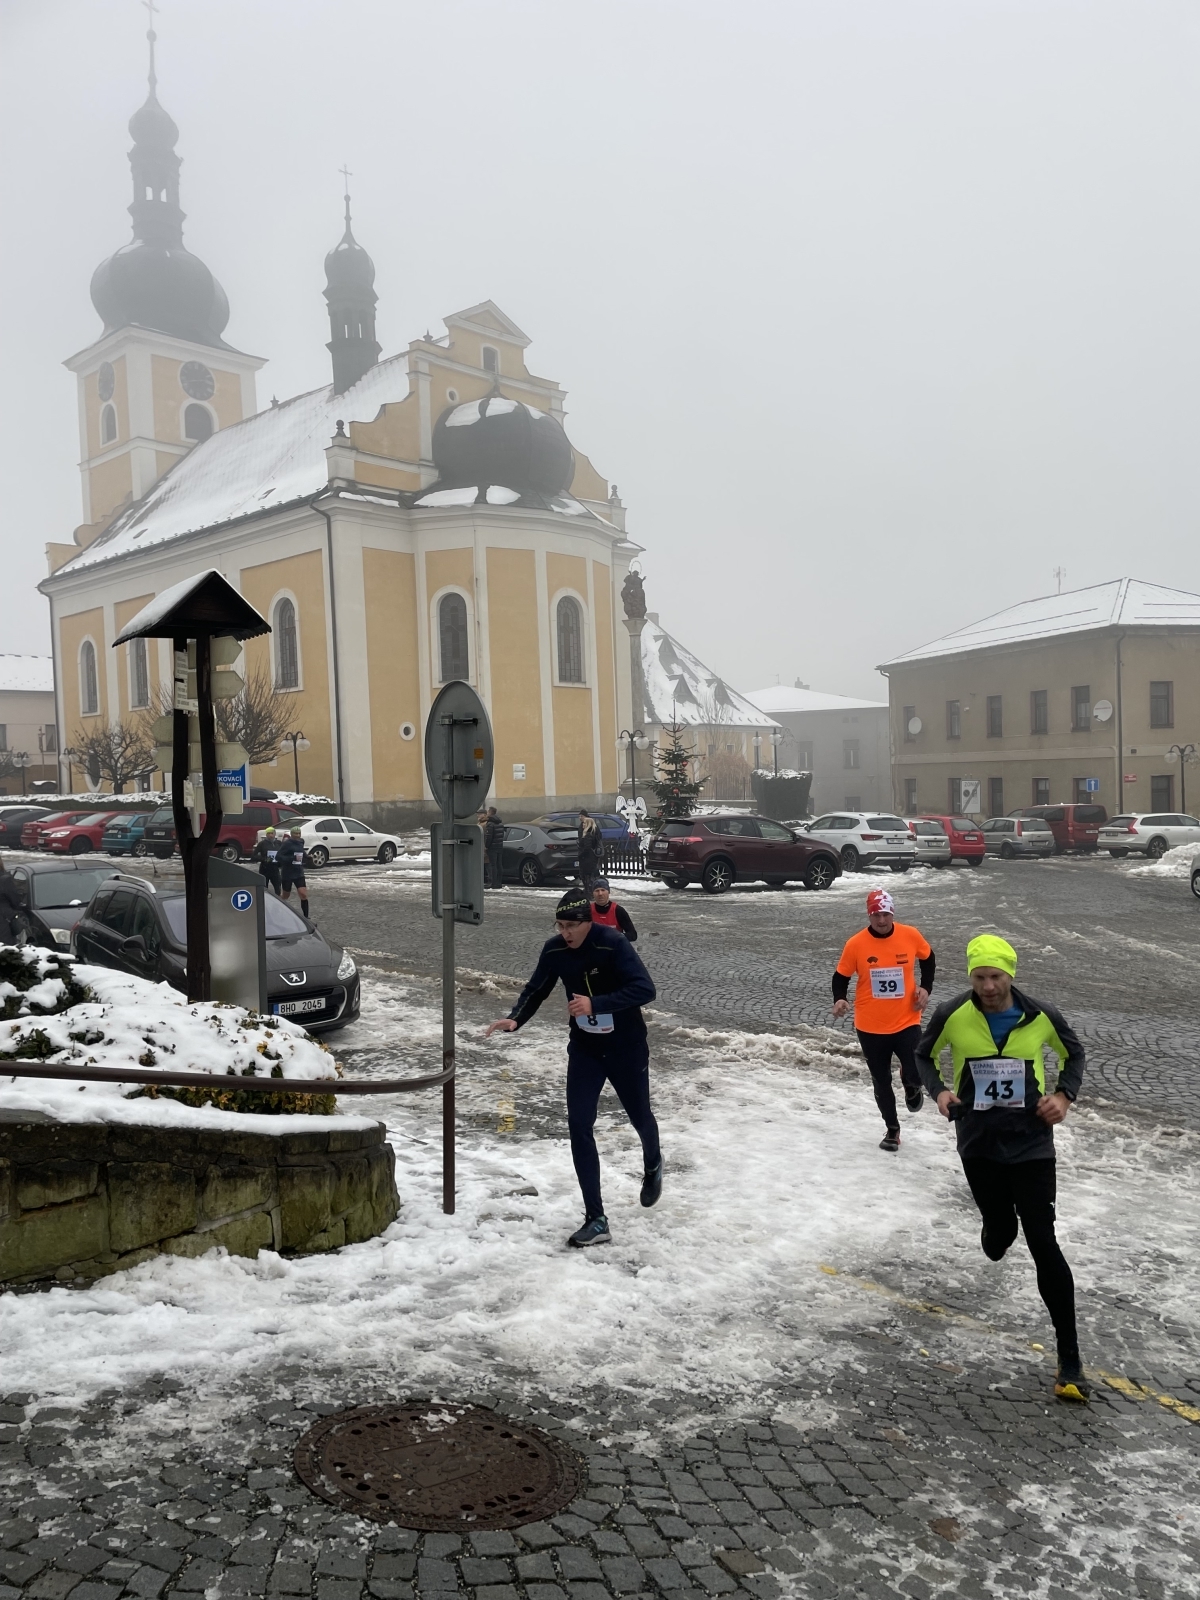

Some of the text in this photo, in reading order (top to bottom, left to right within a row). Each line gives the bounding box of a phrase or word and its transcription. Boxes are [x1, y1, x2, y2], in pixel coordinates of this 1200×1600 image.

[237, 894, 248, 908] P
[878, 980, 898, 993] 39
[302, 999, 322, 1010] 2045
[587, 1013, 598, 1026] 8
[984, 1080, 1014, 1101] 43
